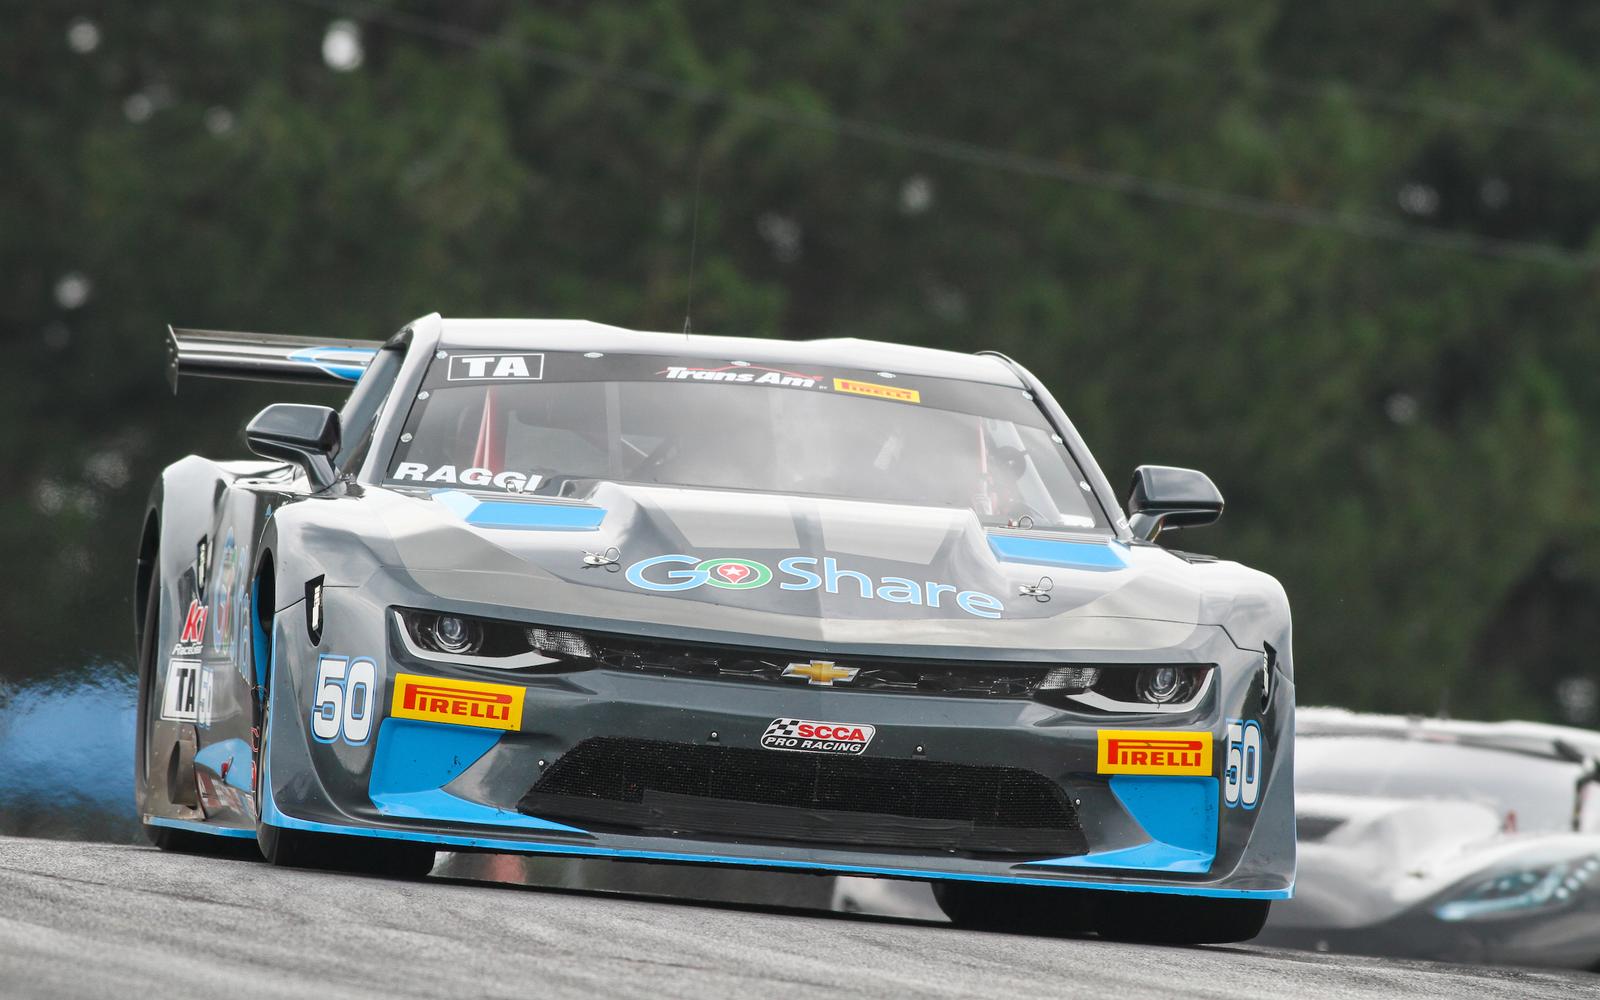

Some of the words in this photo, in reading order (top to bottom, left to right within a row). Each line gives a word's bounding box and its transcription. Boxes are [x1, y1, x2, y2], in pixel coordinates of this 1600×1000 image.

[461, 355, 530, 378] TA
[665, 366, 754, 383] Trans
[755, 372, 815, 388] Am
[840, 381, 912, 400] PIRELLI
[392, 462, 543, 492] RAGGI
[181, 599, 208, 645] K1
[175, 668, 197, 712] TA
[311, 654, 377, 747] 50
[403, 684, 513, 721] PIRELLI
[765, 737, 798, 748] PRO
[800, 740, 862, 753] RACING
[798, 724, 866, 742] SCCA
[1107, 739, 1203, 767] PIRELLI
[1224, 718, 1262, 810] 50
